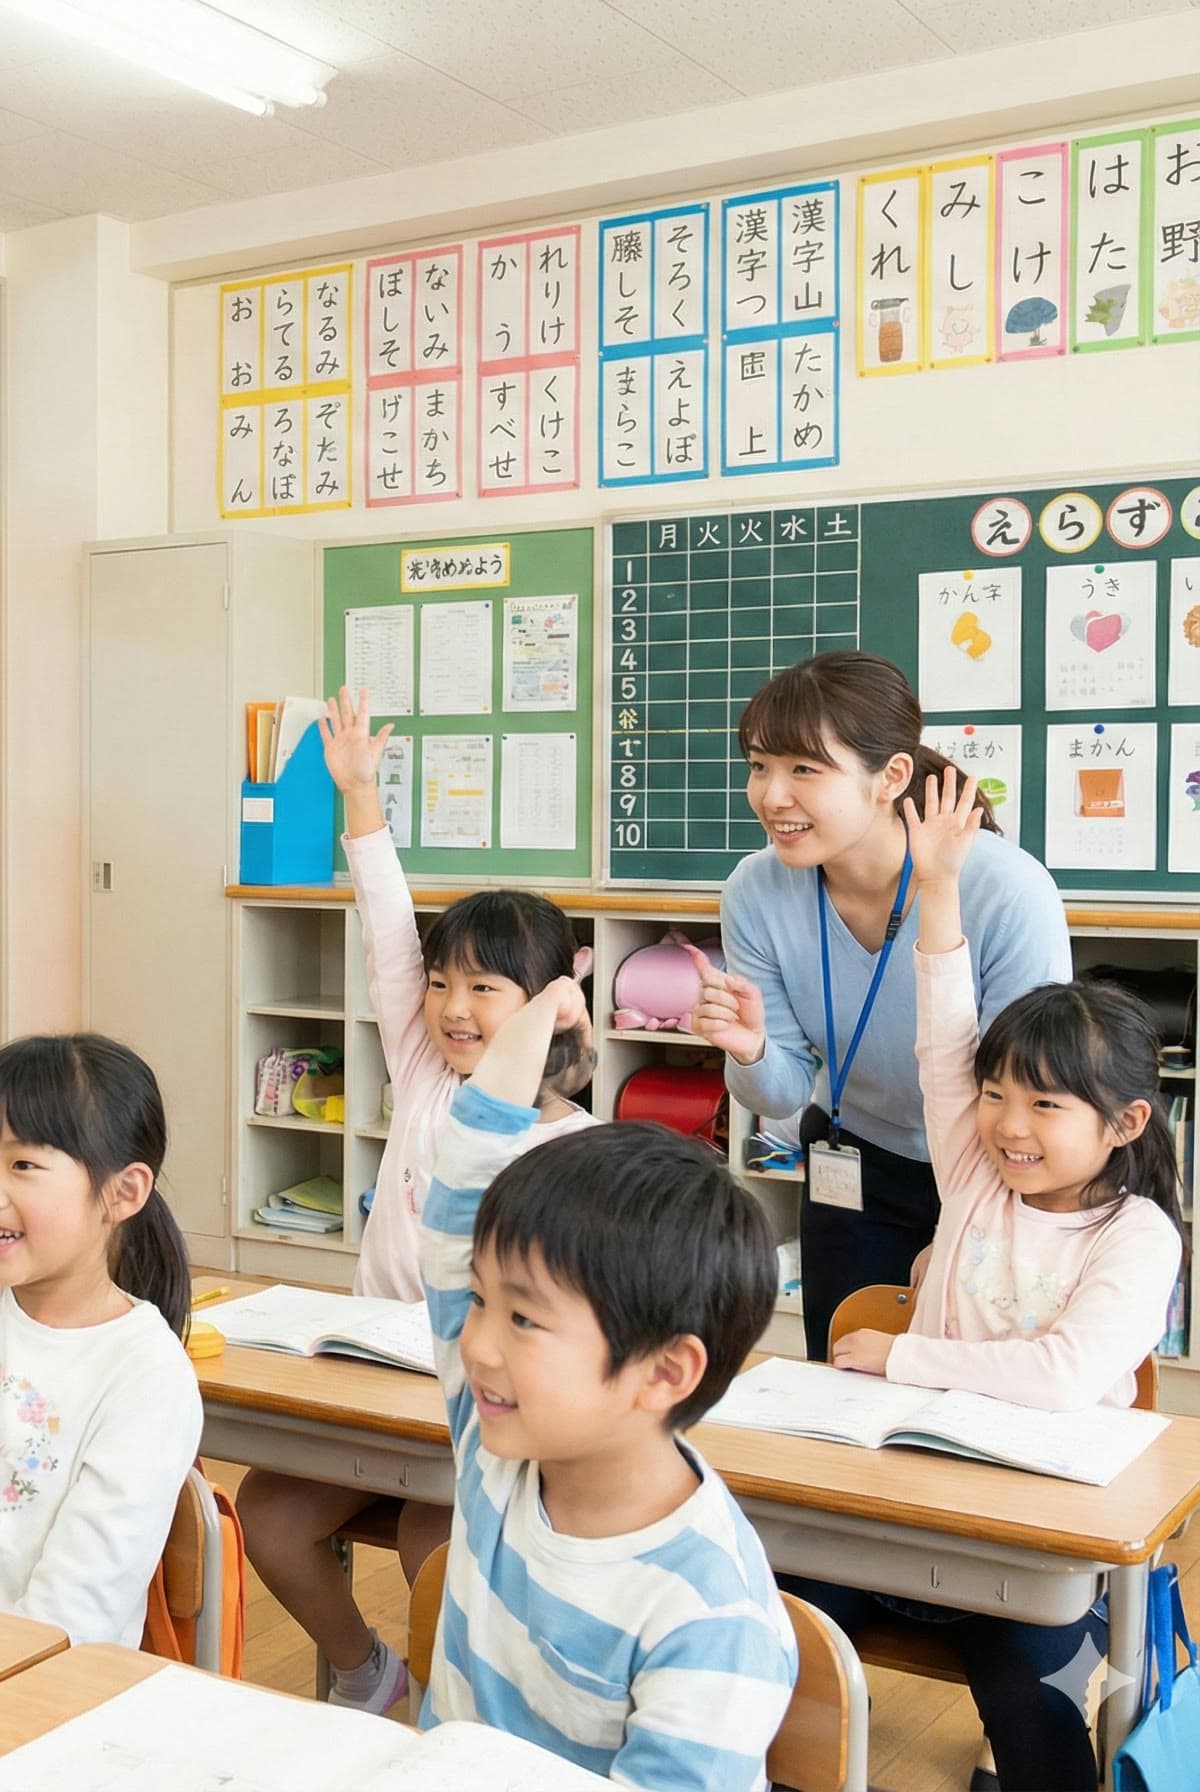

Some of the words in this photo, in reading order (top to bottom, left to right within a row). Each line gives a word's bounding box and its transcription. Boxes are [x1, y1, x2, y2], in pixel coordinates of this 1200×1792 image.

[731, 205, 769, 314] 漢字つ
[787, 195, 826, 311] 漢字山
[870, 189, 911, 281] くれ
[939, 181, 981, 291] みし
[1012, 170, 1052, 285] こけ
[1088, 153, 1130, 274] はた
[422, 263, 450, 360] ないみ
[538, 244, 569, 345] れりけ
[666, 224, 694, 328] そろく
[273, 288, 295, 381] らてる
[315, 281, 340, 375] なるみ
[376, 393, 404, 490] げこせ
[423, 388, 450, 487] まかち
[488, 381, 517, 479] すべせ
[540, 375, 565, 474] くけこ
[666, 359, 697, 465] えよぽ
[792, 342, 825, 449] たかめ
[626, 560, 633, 582] 1
[658, 523, 677, 549] 月
[697, 520, 725, 551] 火
[739, 518, 768, 547] 火
[780, 514, 807, 541] 水
[823, 512, 852, 537] 土
[621, 588, 637, 612] 2
[621, 618, 637, 641] 3
[939, 583, 1001, 605] かん字
[1081, 578, 1120, 600] うき
[619, 648, 638, 671] 4
[621, 676, 637, 700] 5
[620, 764, 637, 788] 8
[1068, 738, 1134, 759] まかん
[615, 823, 641, 847] 10
[619, 793, 637, 817] 9
